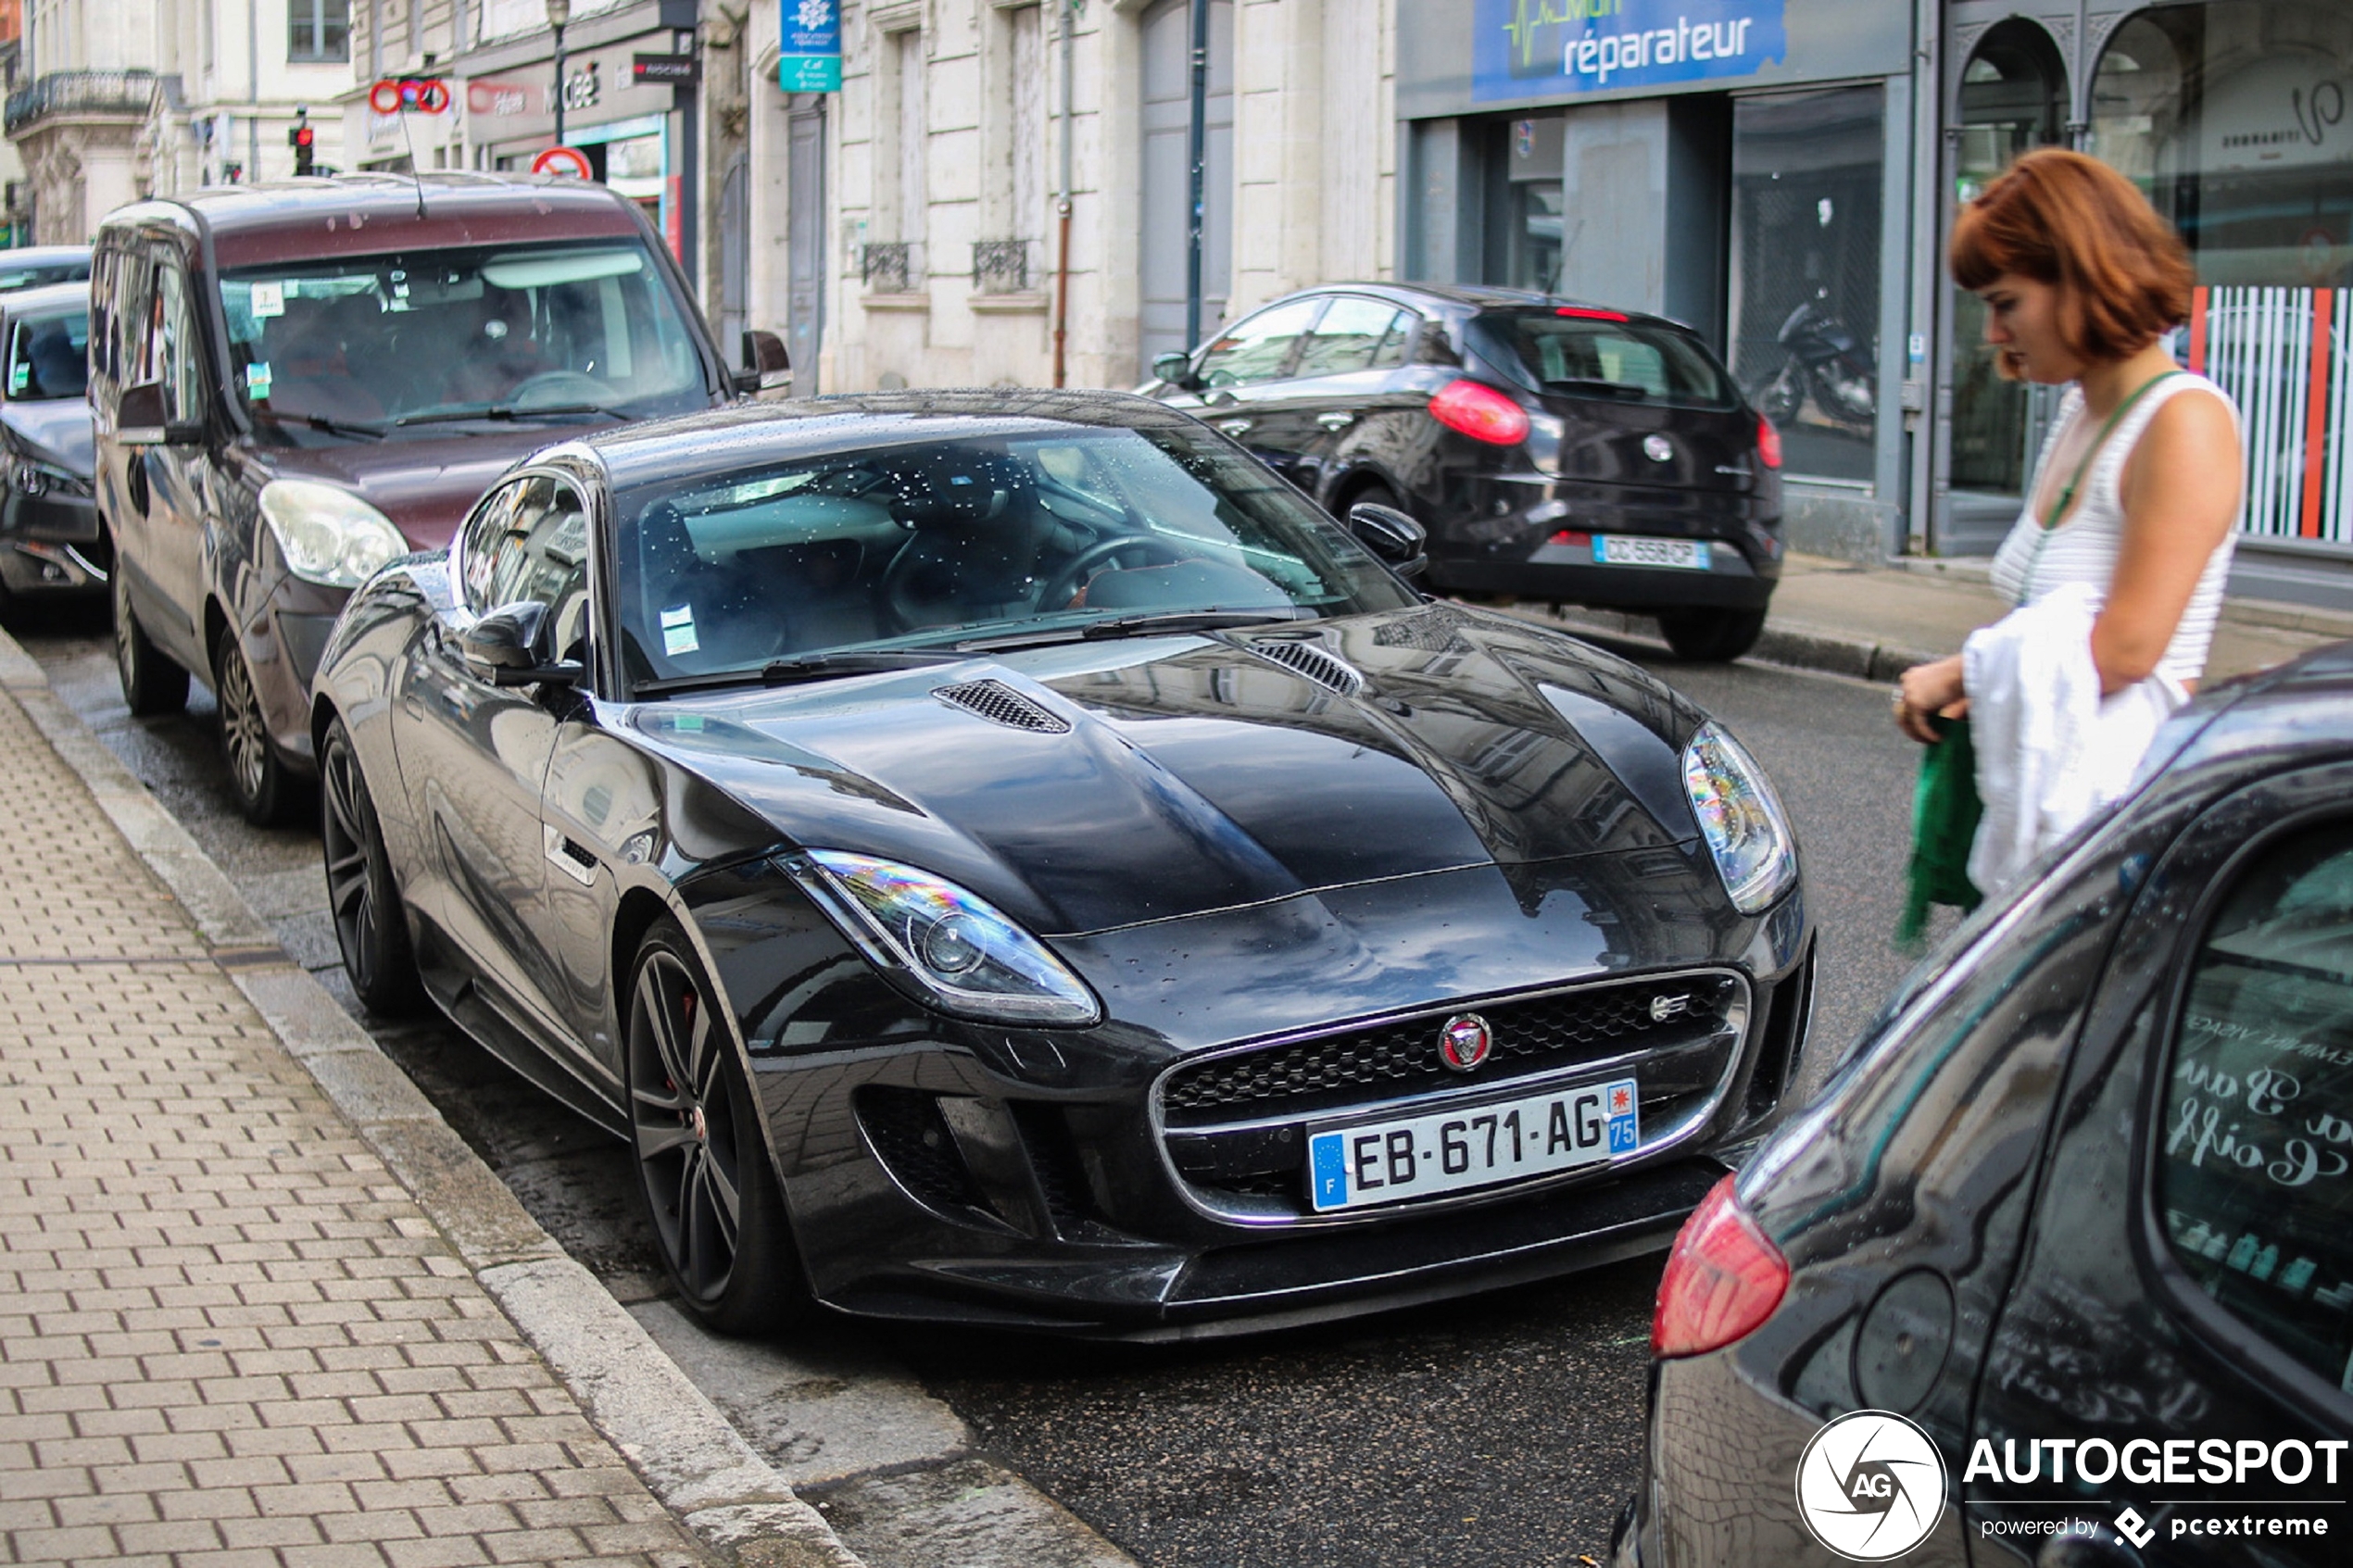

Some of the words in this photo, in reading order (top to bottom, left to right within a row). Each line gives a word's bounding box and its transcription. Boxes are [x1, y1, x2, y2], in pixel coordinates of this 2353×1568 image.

[1564, 16, 1753, 84] réparateur
[1353, 1094, 1602, 1191] EB-671-AG
[1610, 1119, 1635, 1147] 75
[1326, 1178, 1335, 1195] F
